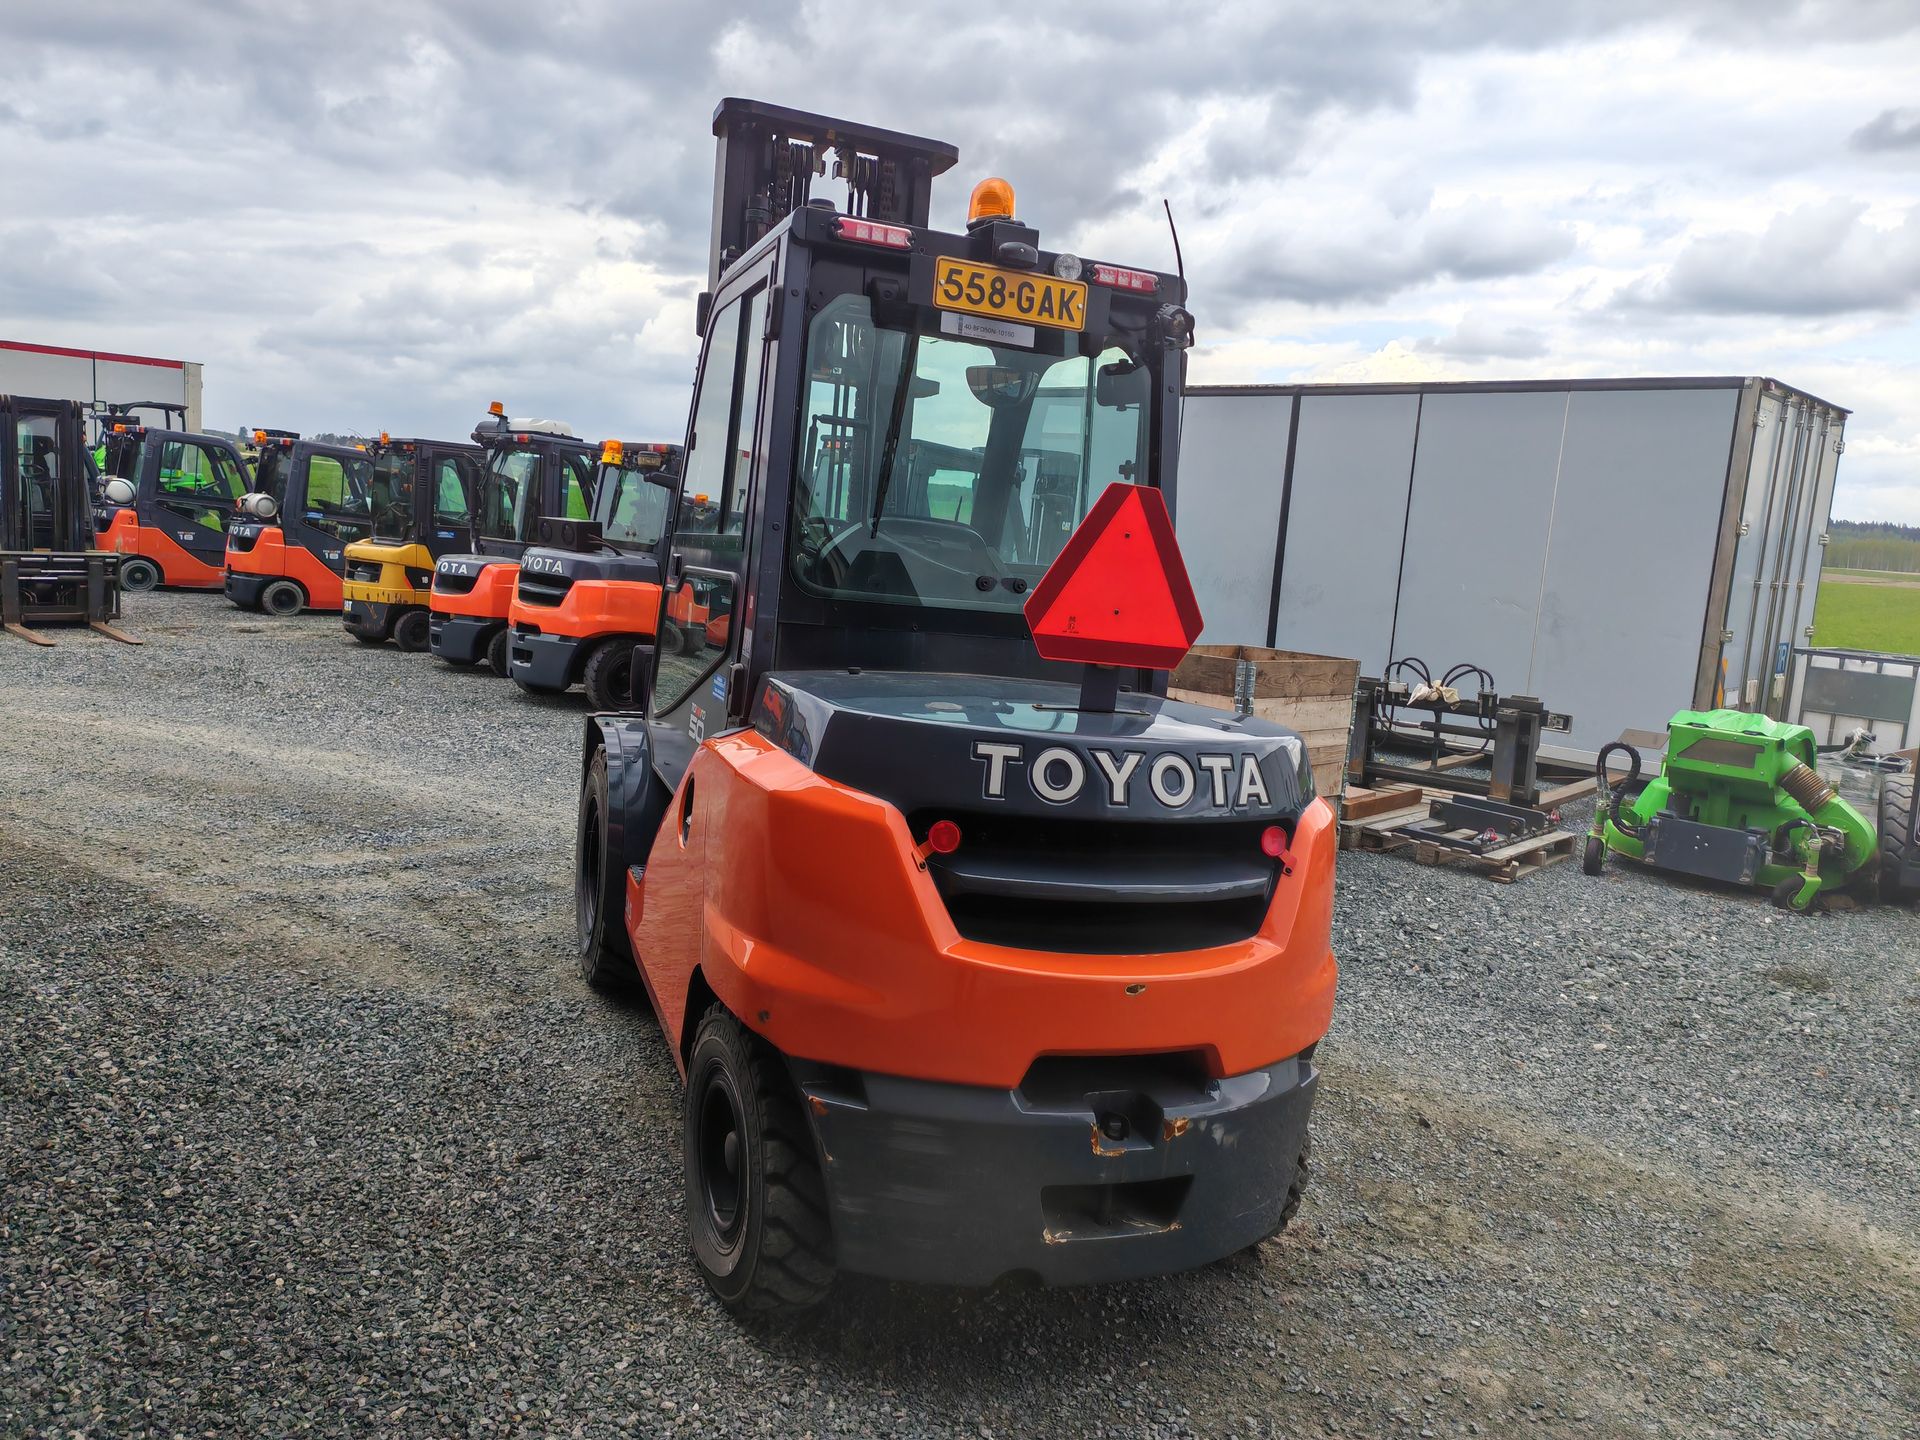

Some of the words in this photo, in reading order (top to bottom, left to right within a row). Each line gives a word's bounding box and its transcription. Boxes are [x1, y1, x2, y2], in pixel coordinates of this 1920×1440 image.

[943, 268, 1077, 322] 558-GAK
[688, 713, 704, 745] 50
[973, 742, 1271, 808] TOYOTA
